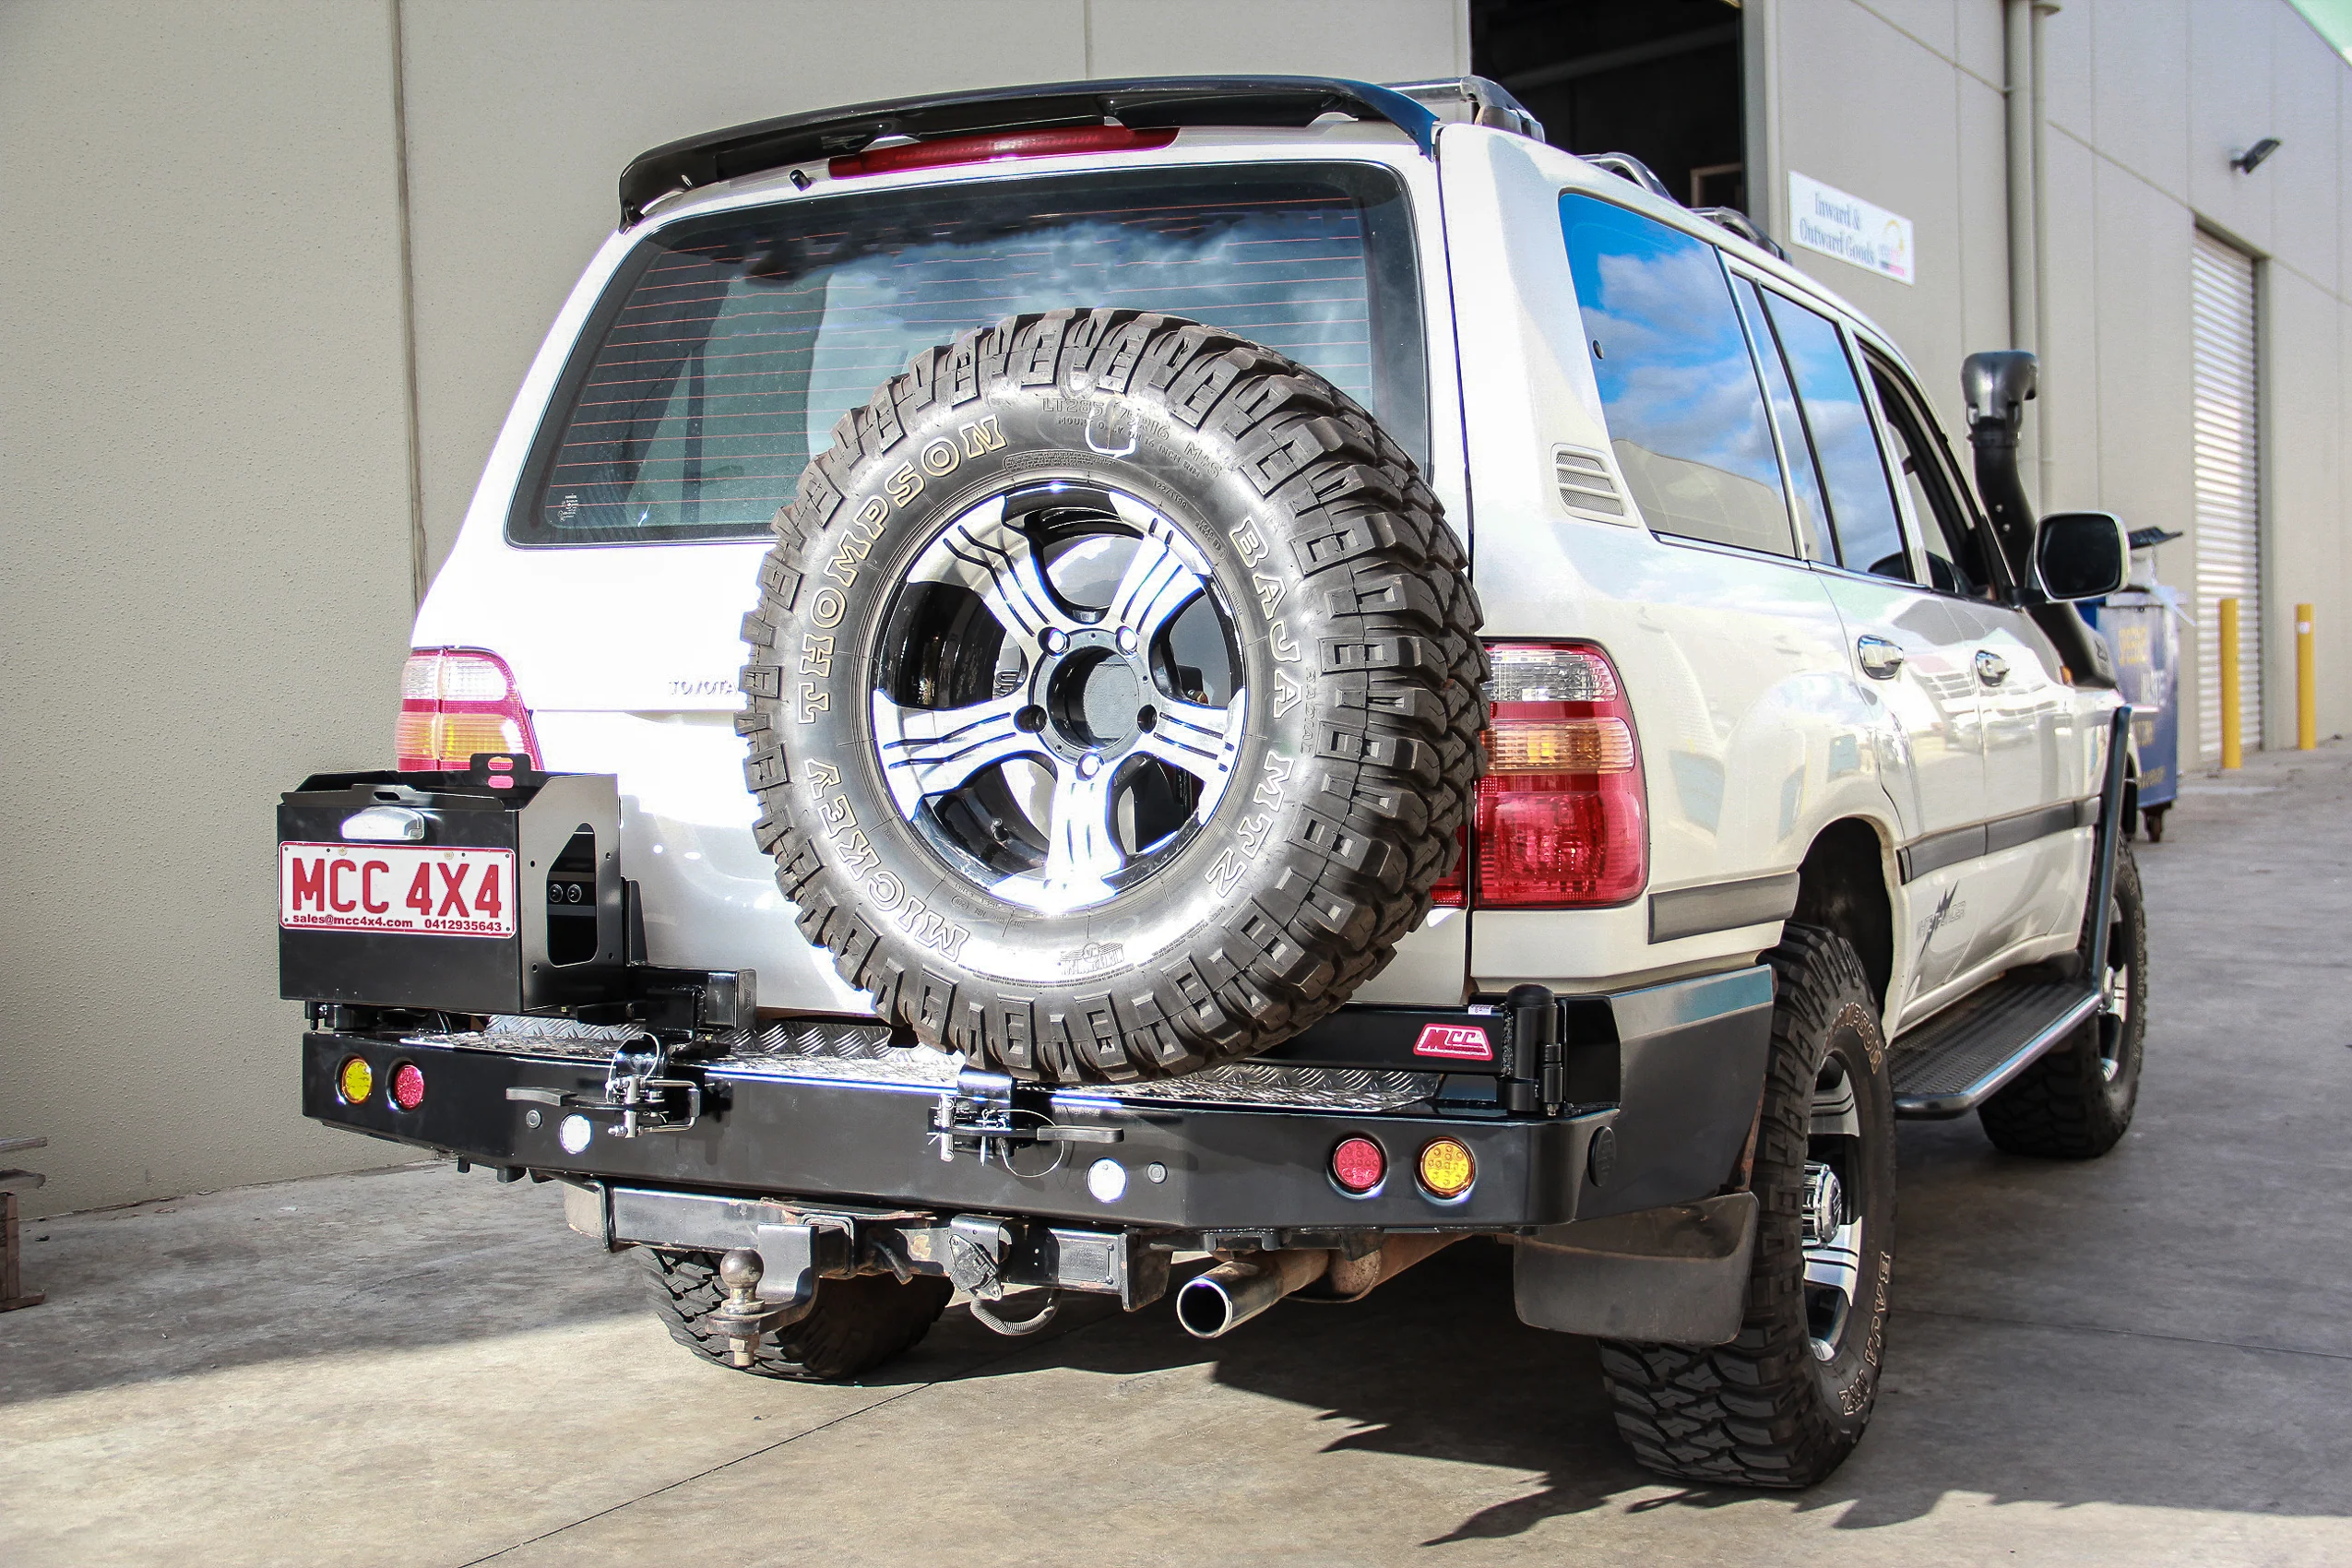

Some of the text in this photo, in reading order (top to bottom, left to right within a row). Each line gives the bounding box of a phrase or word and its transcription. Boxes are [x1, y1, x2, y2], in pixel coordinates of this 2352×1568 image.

[1814, 192, 1860, 231] Inward &
[1800, 218, 1844, 255] Outward
[1846, 234, 1876, 266] Goods
[1158, 444, 1182, 464] INCH
[798, 413, 1007, 724] THOMPSON
[669, 680, 739, 695] TOYOTA
[1204, 515, 1302, 898] BAJA MTZ
[804, 757, 970, 963] MICKEY
[292, 858, 502, 919] MCC 4X4
[292, 913, 503, 932] sales@mcc4x4.com 0412935643
[1420, 1028, 1484, 1051] MCC
[1864, 1251, 1891, 1367] BAJA
